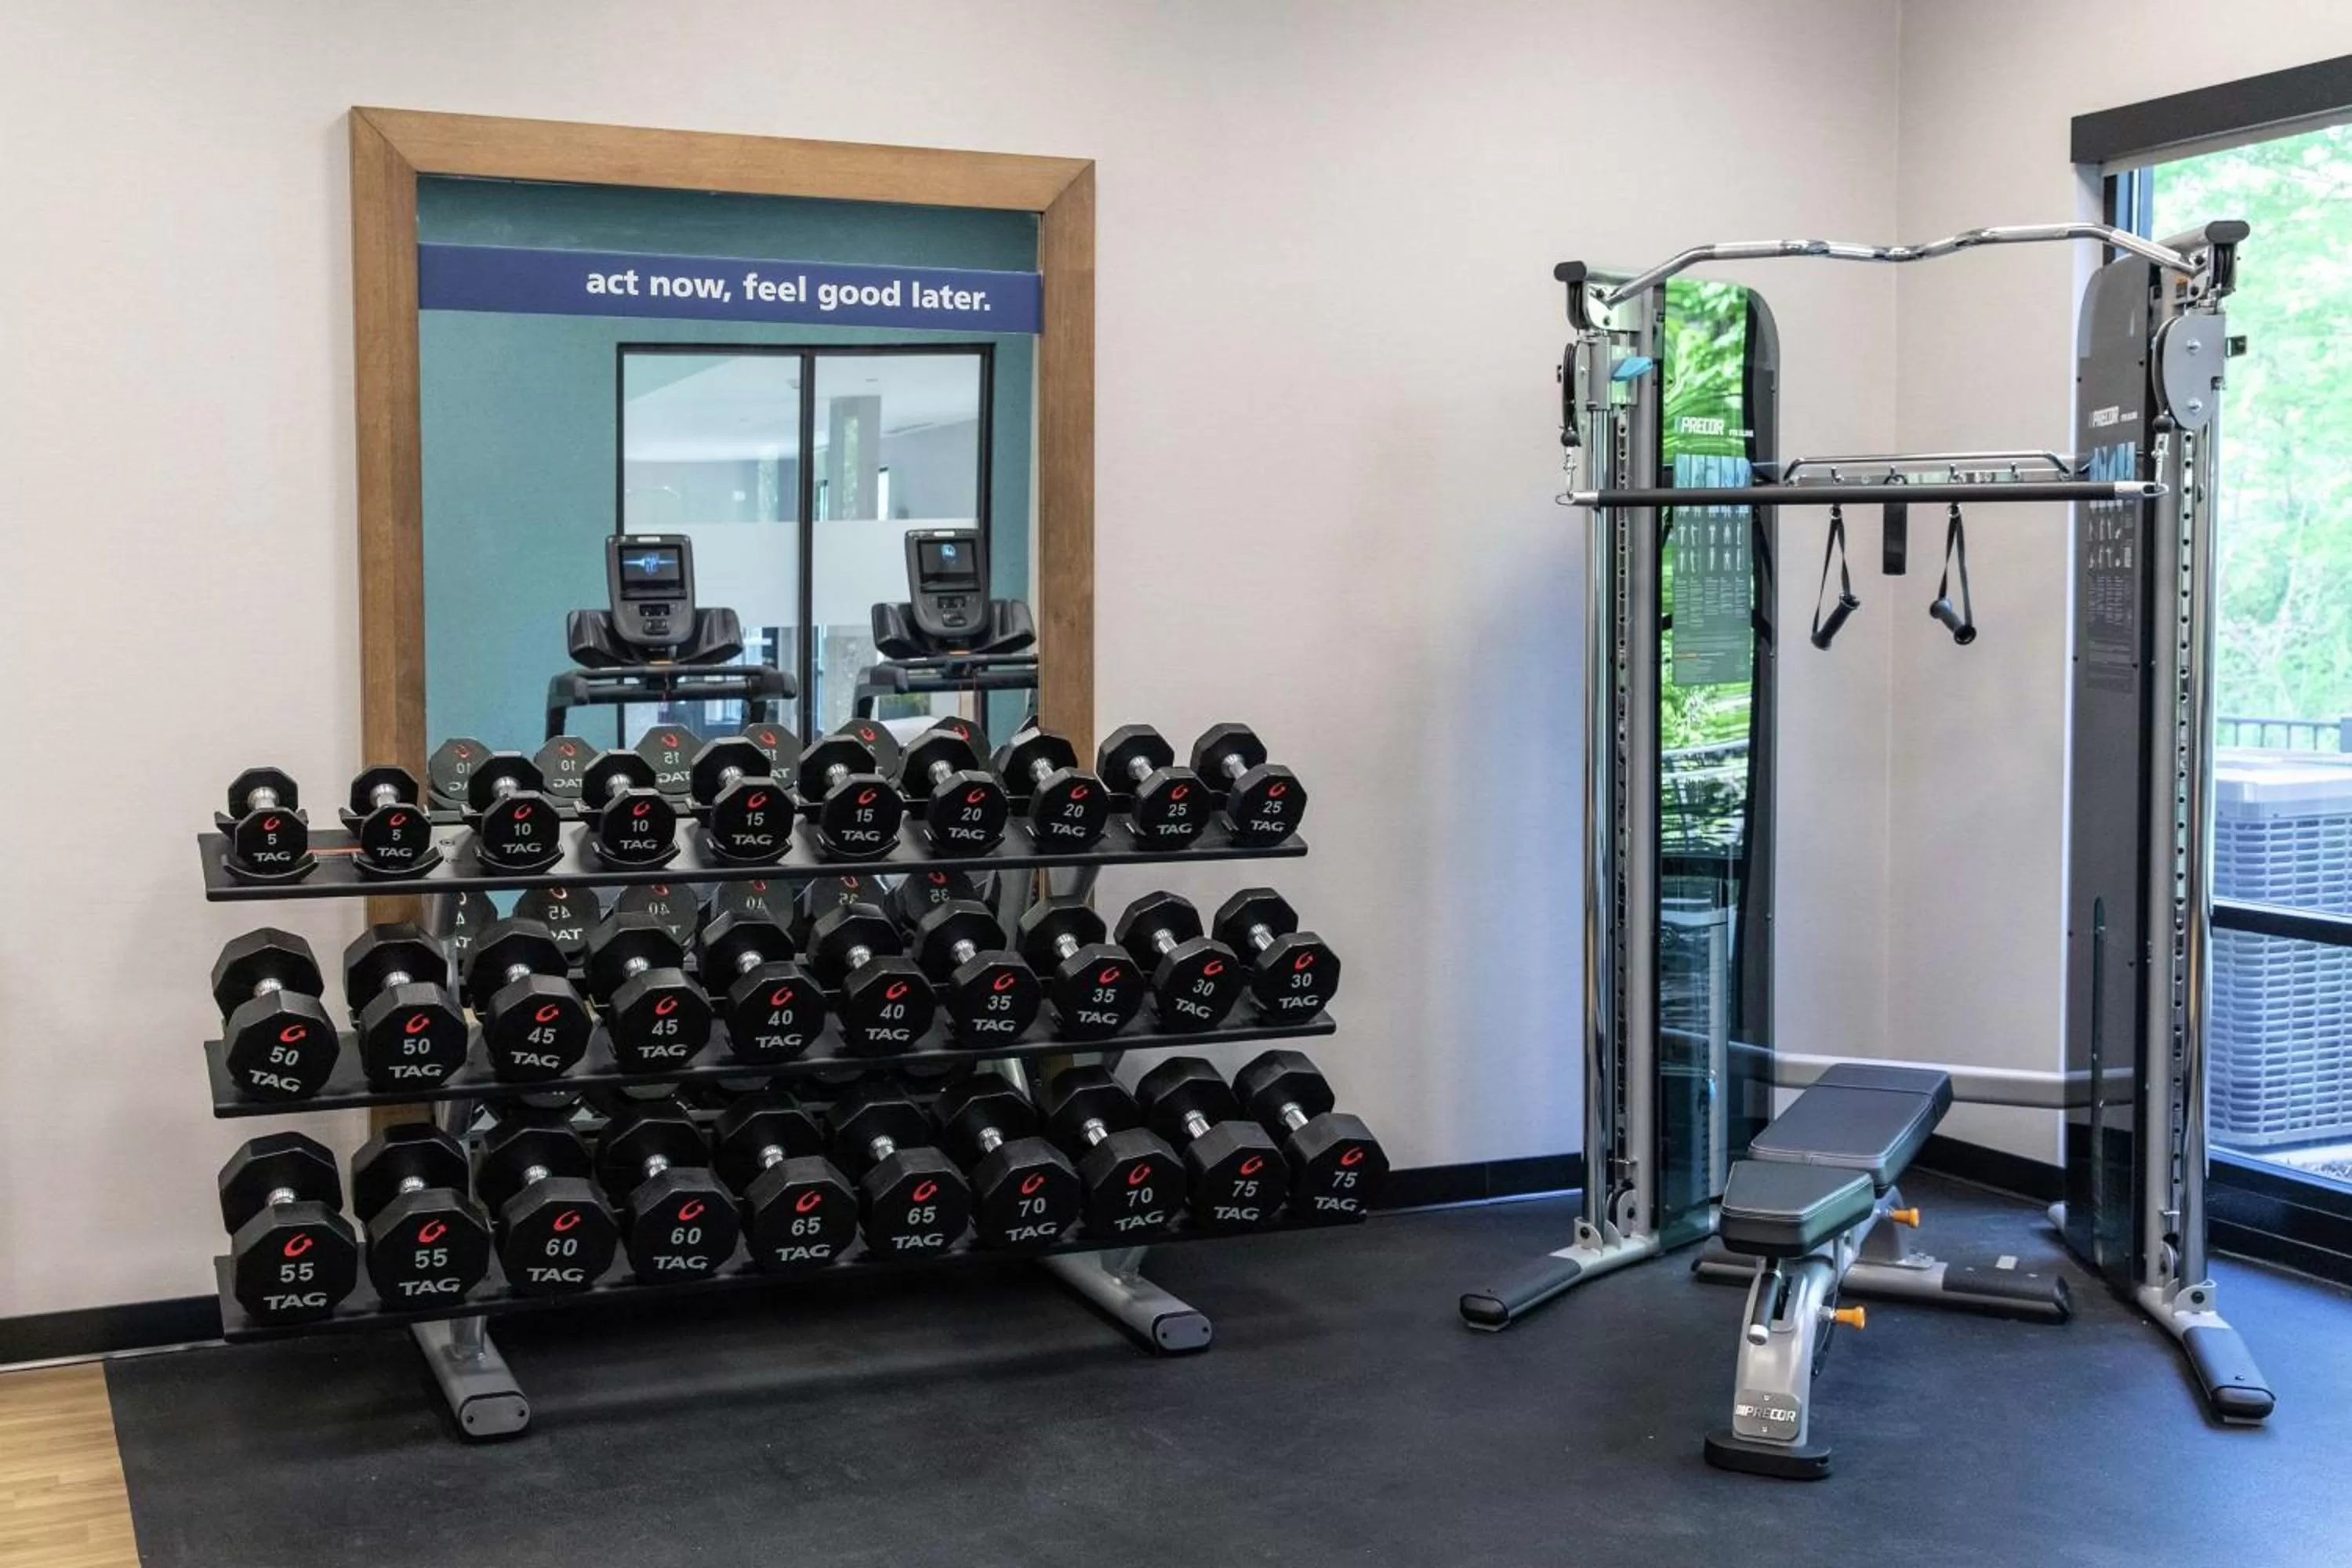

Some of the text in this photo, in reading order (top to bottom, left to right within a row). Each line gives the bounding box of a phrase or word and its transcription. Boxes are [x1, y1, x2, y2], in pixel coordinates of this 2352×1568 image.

[586, 270, 991, 312] act now, feel good later.
[1681, 416, 1724, 436] PRECOR
[1063, 804, 1083, 818] 20
[1168, 804, 1187, 817] 25
[1263, 800, 1283, 813] 25
[746, 812, 764, 826] 15
[856, 809, 873, 822] 15
[961, 808, 982, 821] 20
[514, 823, 531, 836] 10
[633, 820, 648, 832] 10
[1051, 822, 1085, 837] TAG
[1157, 823, 1192, 834] TAG
[1251, 820, 1285, 832] TAG
[268, 833, 277, 845] 5
[392, 829, 401, 840] 5
[732, 834, 772, 845] TAG
[842, 830, 880, 841] TAG
[949, 828, 985, 840] TAG
[502, 843, 541, 853] TAG
[620, 840, 657, 849] TAG
[253, 851, 291, 862] TAG
[376, 848, 412, 857] TAG
[1193, 978, 1214, 996] 30
[1292, 973, 1312, 988] 30
[988, 996, 1011, 1010] 35
[1093, 989, 1116, 1003] 35
[1279, 995, 1318, 1008] TAG
[880, 1004, 904, 1019] 40
[1176, 998, 1212, 1018] TAG
[768, 1010, 793, 1025] 40
[1078, 1011, 1118, 1025] TAG
[652, 1019, 677, 1035] 45
[972, 1019, 1016, 1032] TAG
[528, 1027, 556, 1044] 45
[755, 1034, 801, 1047] TAG
[866, 1029, 909, 1040] TAG
[404, 1038, 430, 1054] 50
[638, 1044, 687, 1058] TAG
[270, 1046, 299, 1065] 50
[511, 1051, 560, 1068] TAG
[389, 1064, 441, 1078] TAG
[249, 1069, 301, 1091] TAG
[1332, 1171, 1358, 1188] 75
[1232, 1181, 1258, 1196] 75
[1127, 1188, 1152, 1207] 70
[1314, 1196, 1357, 1211] TAG
[1019, 1198, 1046, 1217] 70
[1214, 1207, 1259, 1221] TAG
[908, 1206, 936, 1225] 65
[1115, 1210, 1163, 1231] TAG
[792, 1217, 821, 1236] 65
[1006, 1222, 1057, 1241] TAG
[671, 1228, 701, 1244] 60
[891, 1233, 943, 1249] TAG
[546, 1239, 577, 1256] 60
[776, 1244, 830, 1261] TAG
[416, 1248, 447, 1269] 55
[653, 1256, 708, 1269] TAG
[281, 1262, 314, 1283] 55
[527, 1269, 584, 1282] TAG
[399, 1278, 460, 1295] TAG
[263, 1292, 326, 1309] TAG
